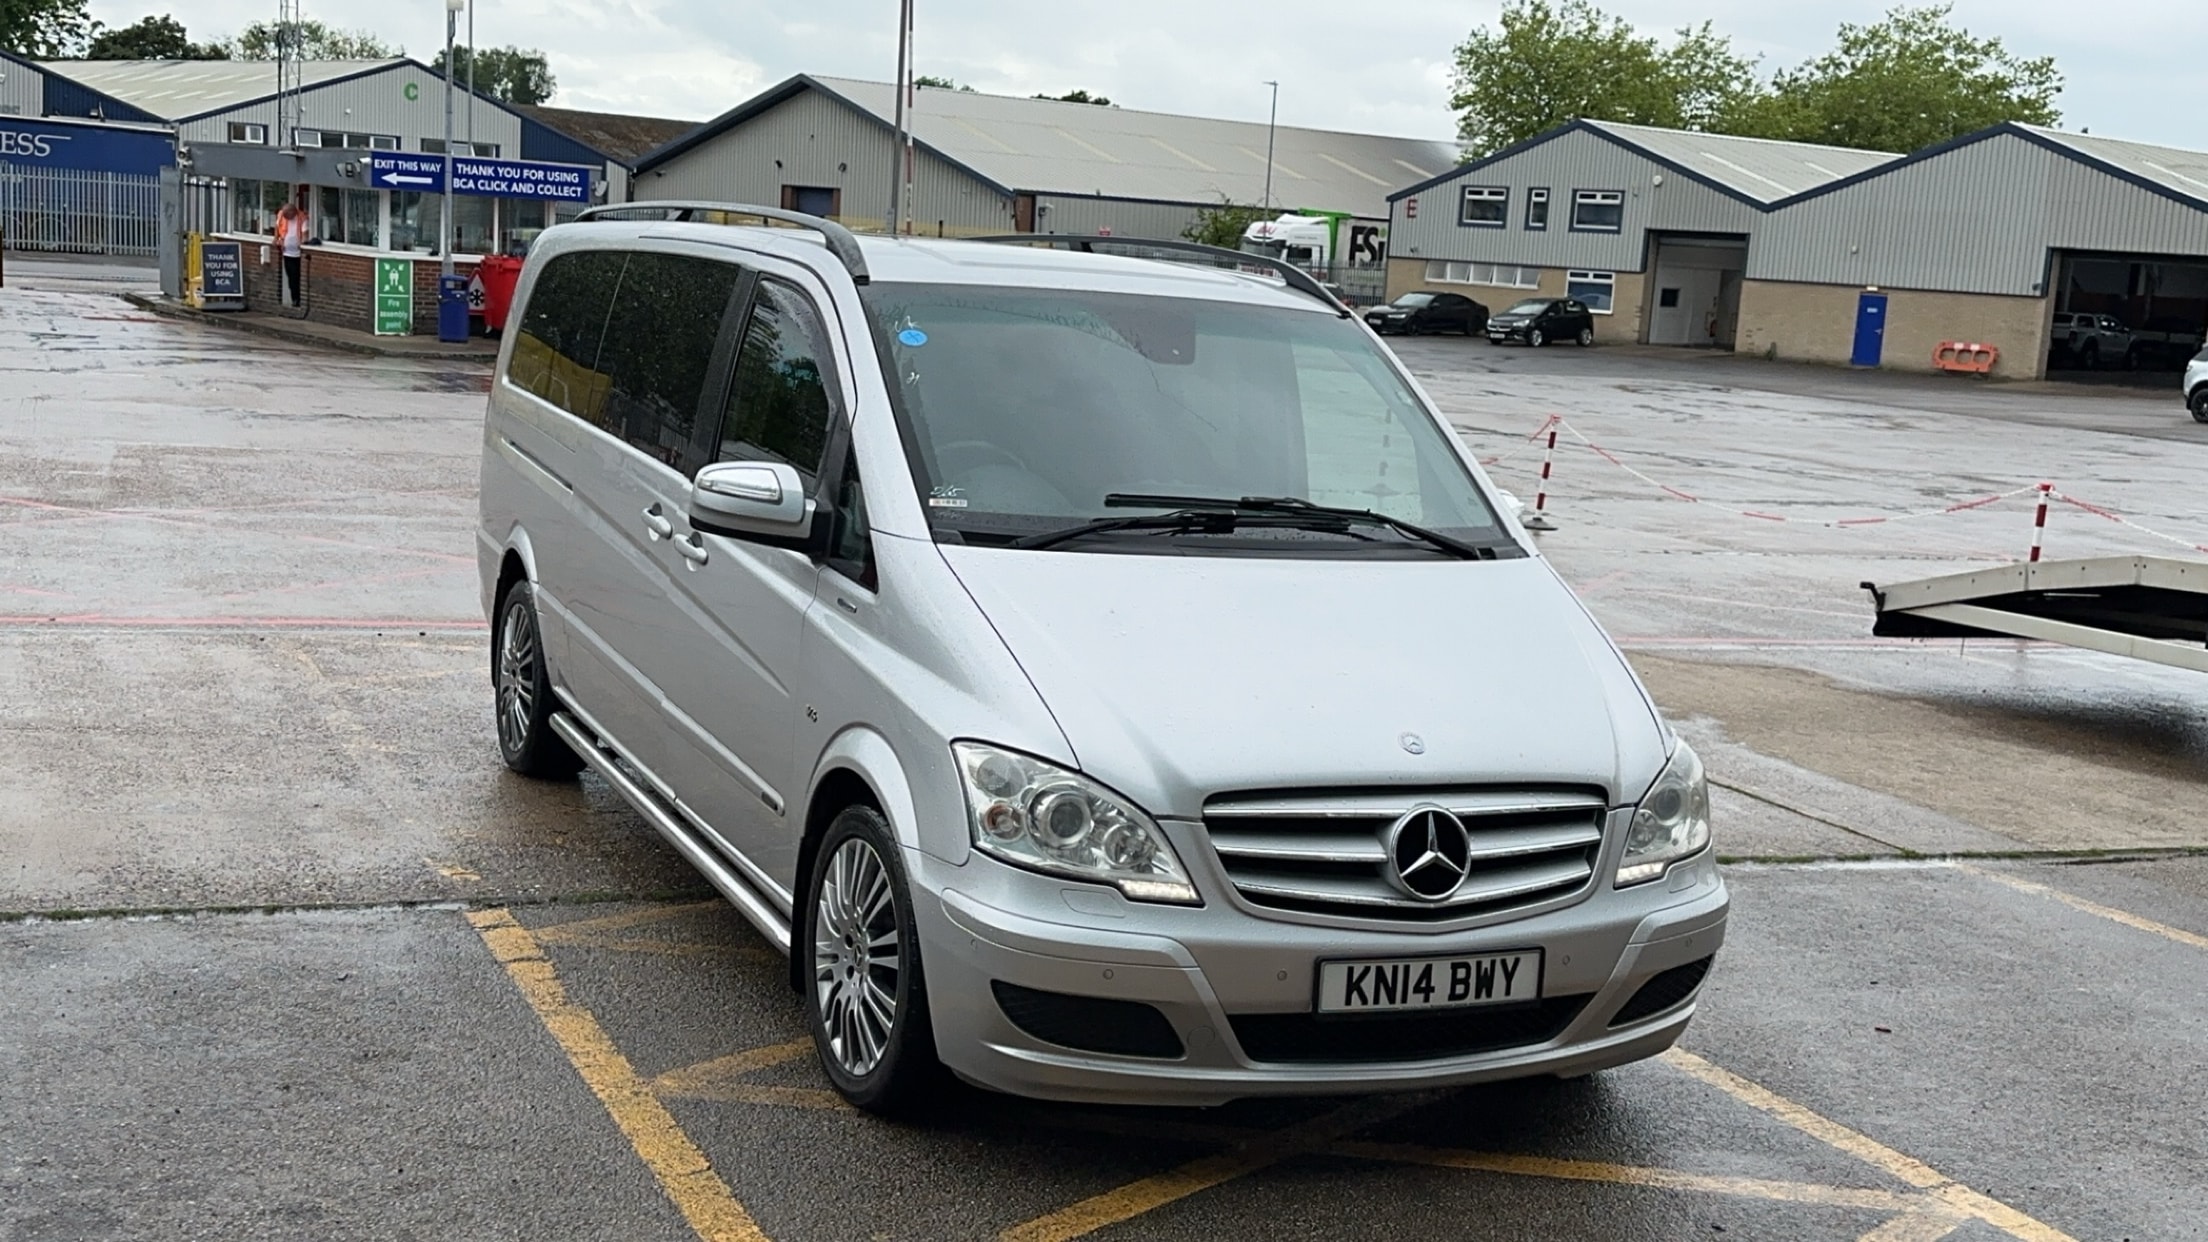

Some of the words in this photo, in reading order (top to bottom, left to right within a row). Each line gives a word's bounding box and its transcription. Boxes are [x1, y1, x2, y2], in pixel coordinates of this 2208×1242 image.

[404, 83, 418, 101] C
[374, 159, 394, 170] EXIT
[397, 160, 419, 171] THIS
[420, 162, 442, 173] WAY
[456, 163, 495, 177] THANK
[497, 166, 521, 179] YOU
[523, 168, 545, 181] FOR
[547, 171, 580, 183] USING
[453, 178, 475, 190] BCA
[477, 180, 509, 192] CLICK
[511, 182, 535, 194] AND
[537, 184, 583, 197] COLLECT
[1406, 198, 1418, 218] E
[210, 270, 235, 278] USING
[1344, 963, 1435, 1006] KN14
[1448, 957, 1521, 1001] BWY
